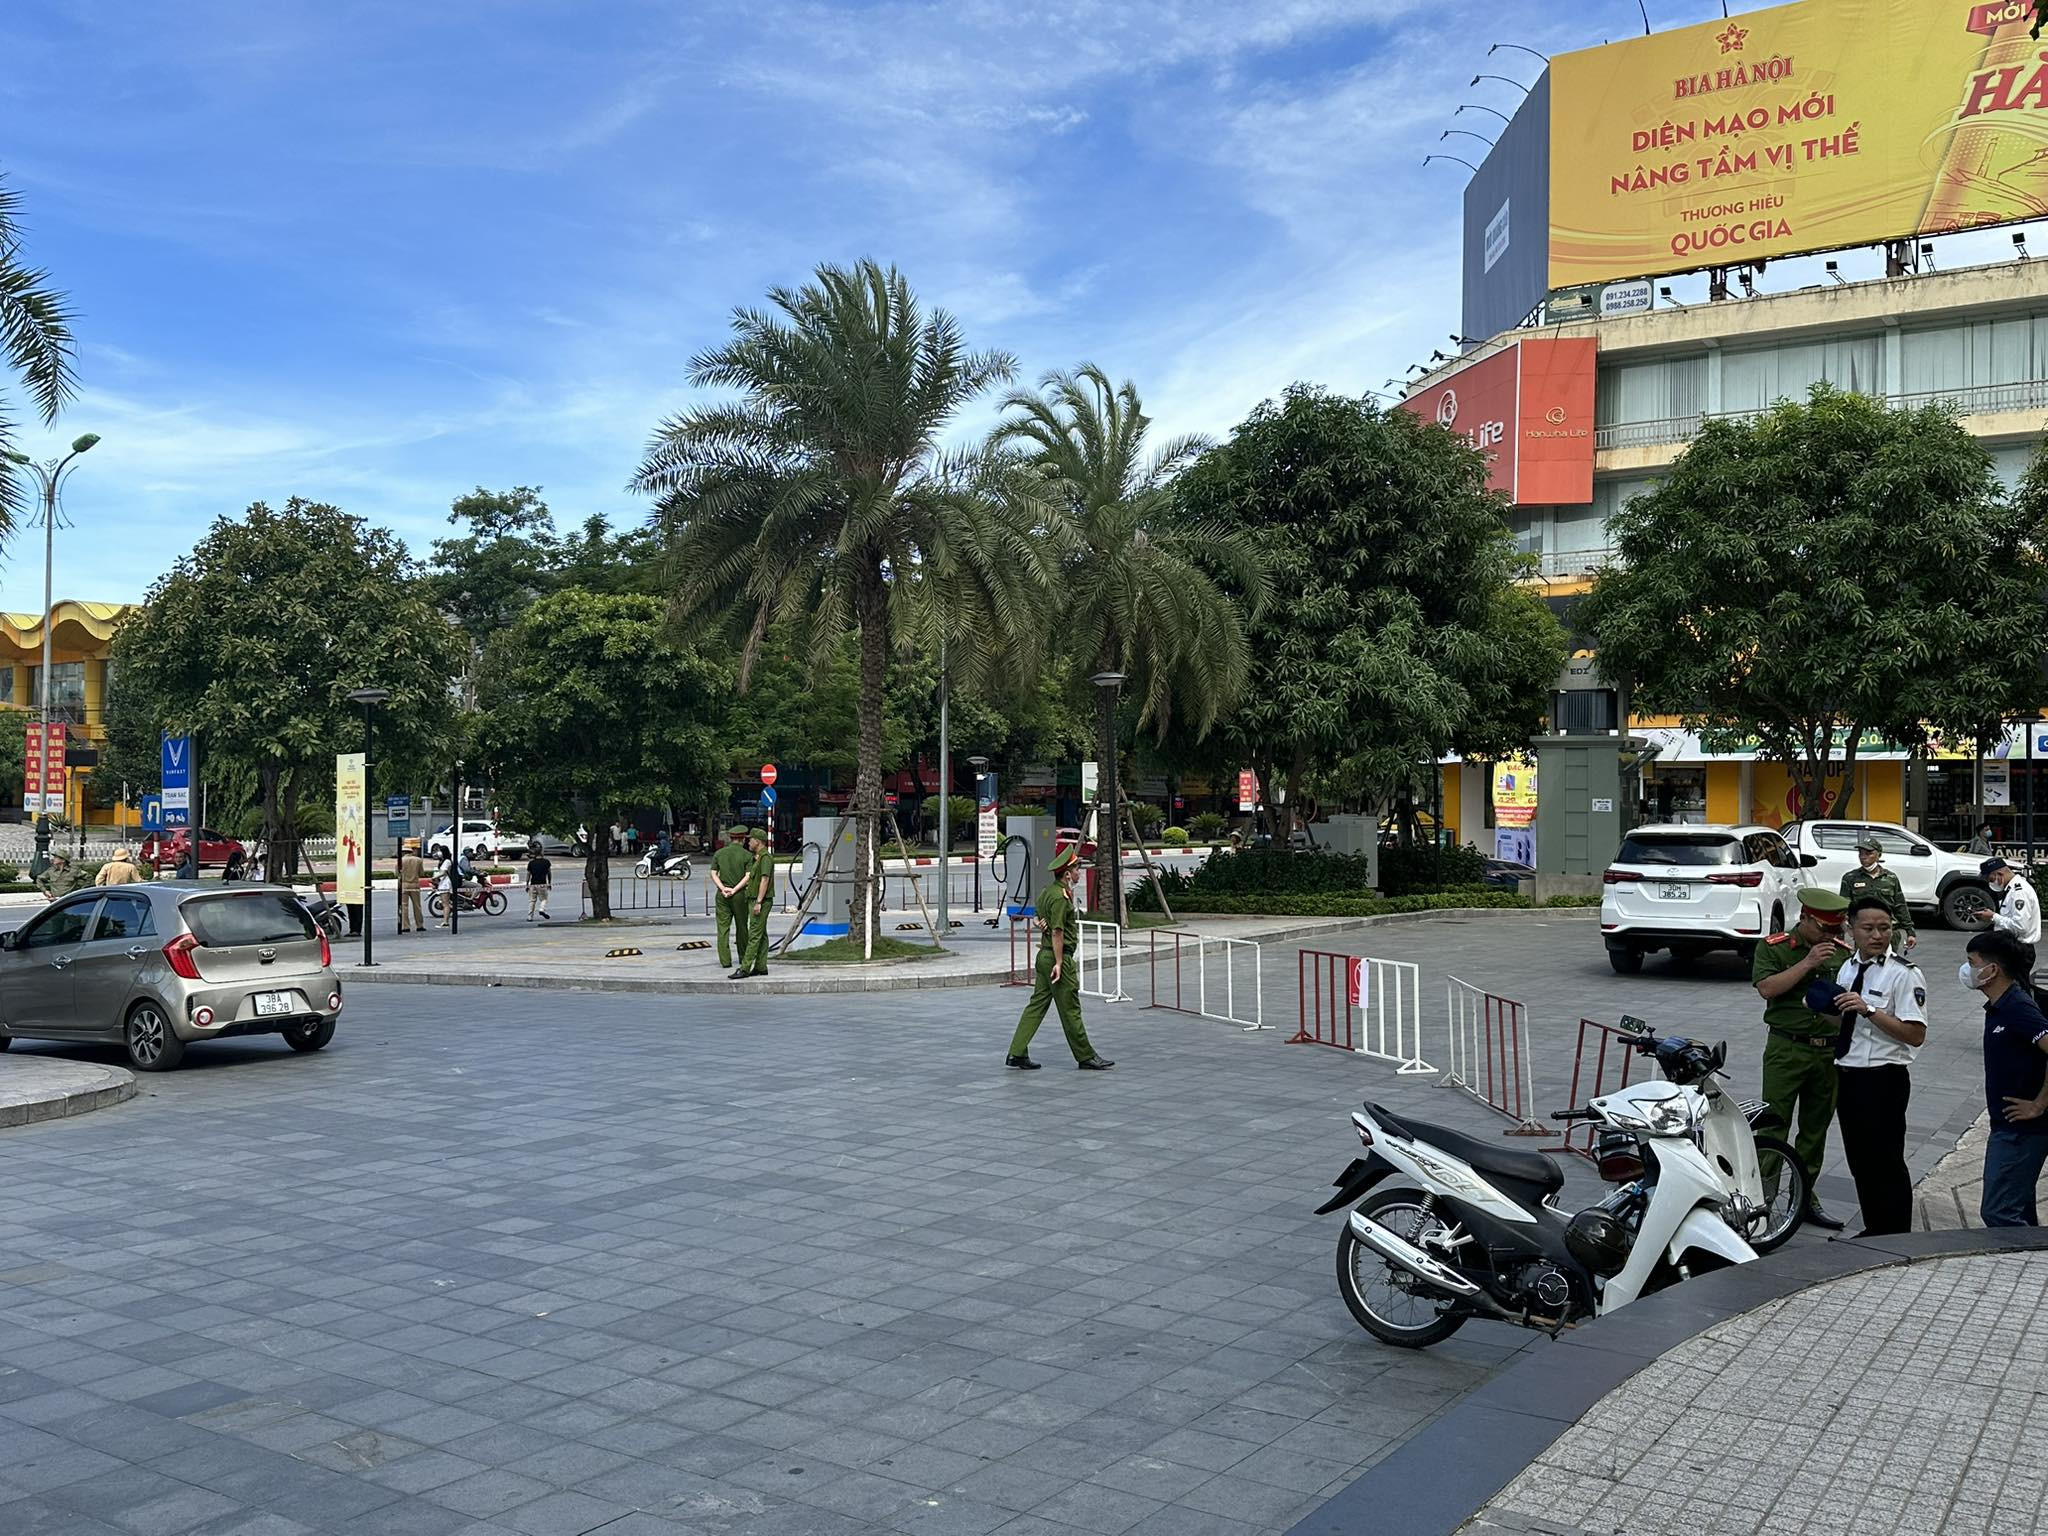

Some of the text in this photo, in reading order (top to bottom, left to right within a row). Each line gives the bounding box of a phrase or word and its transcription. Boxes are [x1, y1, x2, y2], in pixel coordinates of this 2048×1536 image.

[1986, 1, 2027, 25] MỚI
[1674, 55, 1794, 99] BIA HÀ NỘI
[1632, 91, 1835, 152] DIỆN MẠO MỚI
[1611, 121, 1861, 195] NÂNG TẦM VỊ THẾ
[1680, 201, 1745, 222] THƯƠNG
[1671, 217, 1793, 257] QUỐC GIA
[1605, 287, 1648, 300] 091.234.2288
[1526, 428, 1589, 439] Hanwha Life
[266, 993, 282, 1003] 38A
